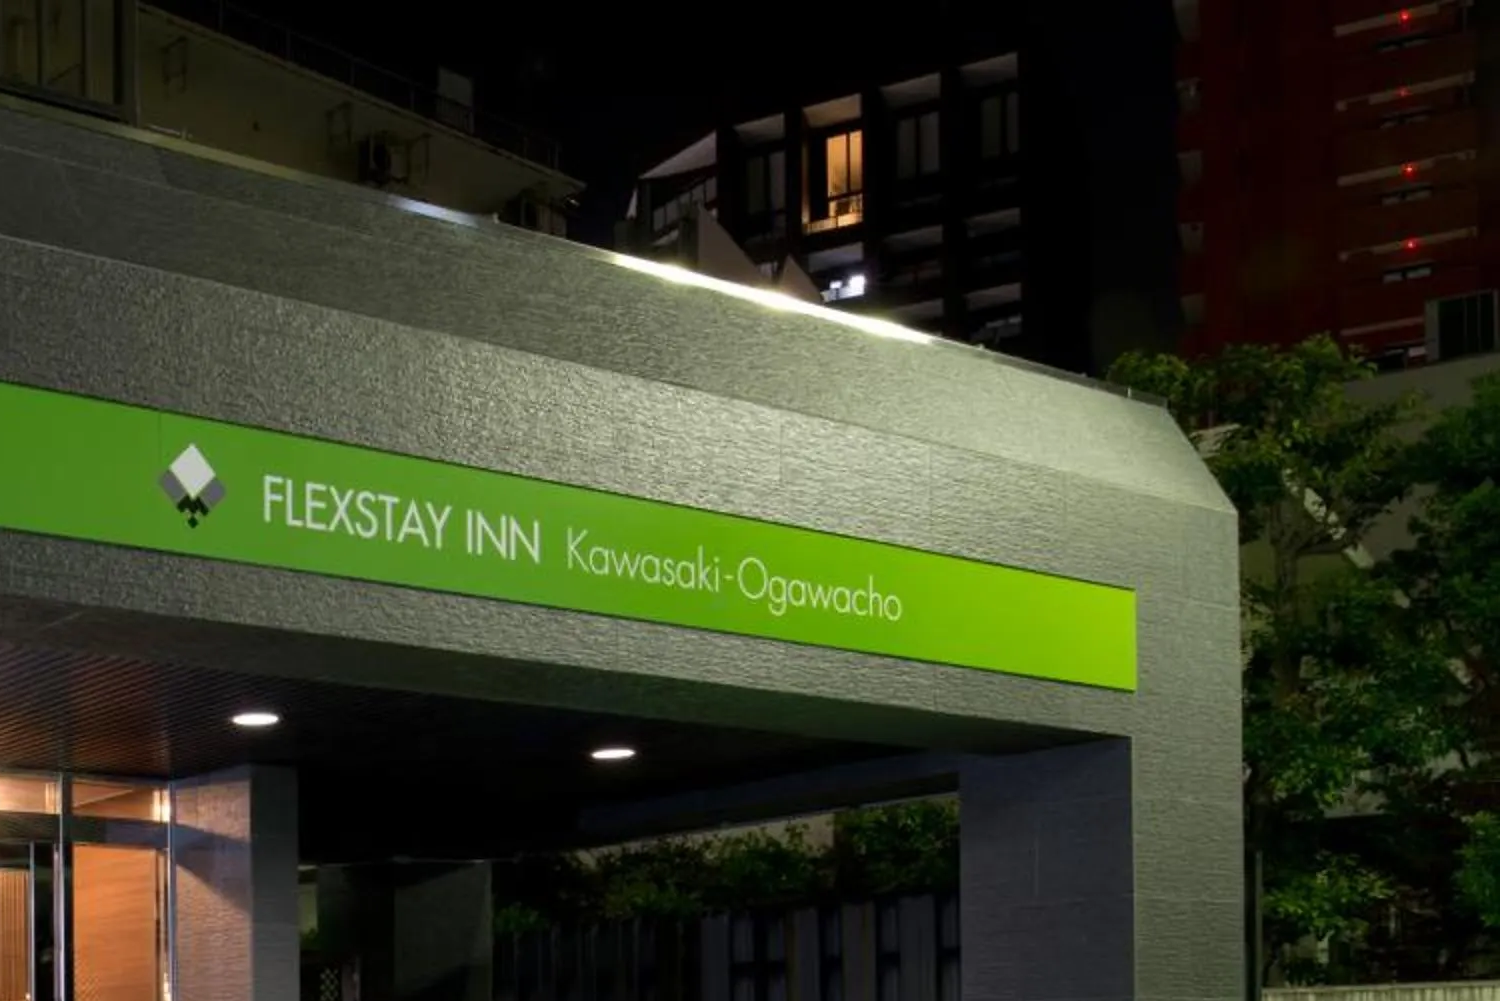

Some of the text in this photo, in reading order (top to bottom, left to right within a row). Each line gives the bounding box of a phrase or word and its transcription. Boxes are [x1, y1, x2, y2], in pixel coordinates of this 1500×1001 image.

[262, 475, 903, 623] FLEXSTAY INN Kawasaki-Ogawacho
